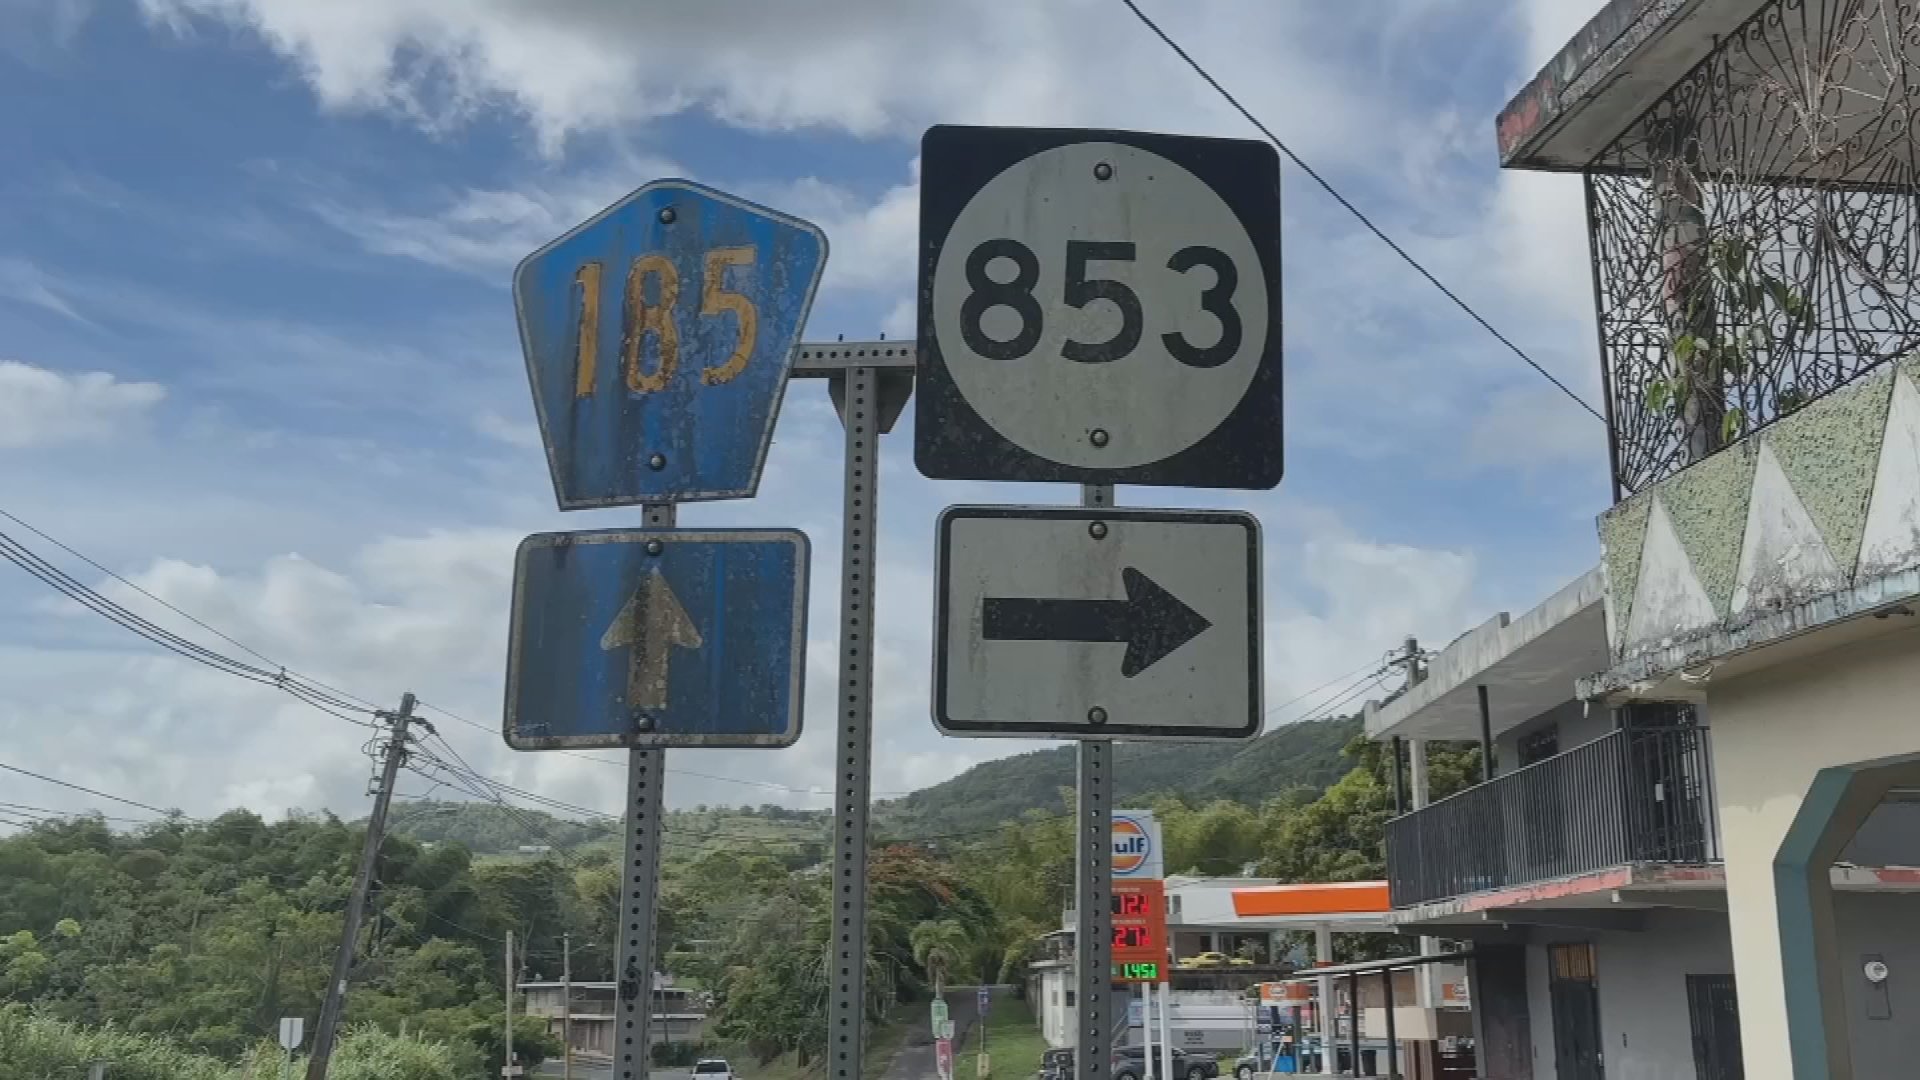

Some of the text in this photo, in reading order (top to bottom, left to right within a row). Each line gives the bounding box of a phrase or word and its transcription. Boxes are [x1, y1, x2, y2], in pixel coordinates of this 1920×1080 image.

[575, 244, 758, 397] 185
[960, 238, 1243, 369] 853
[1112, 837, 1145, 853] ulf
